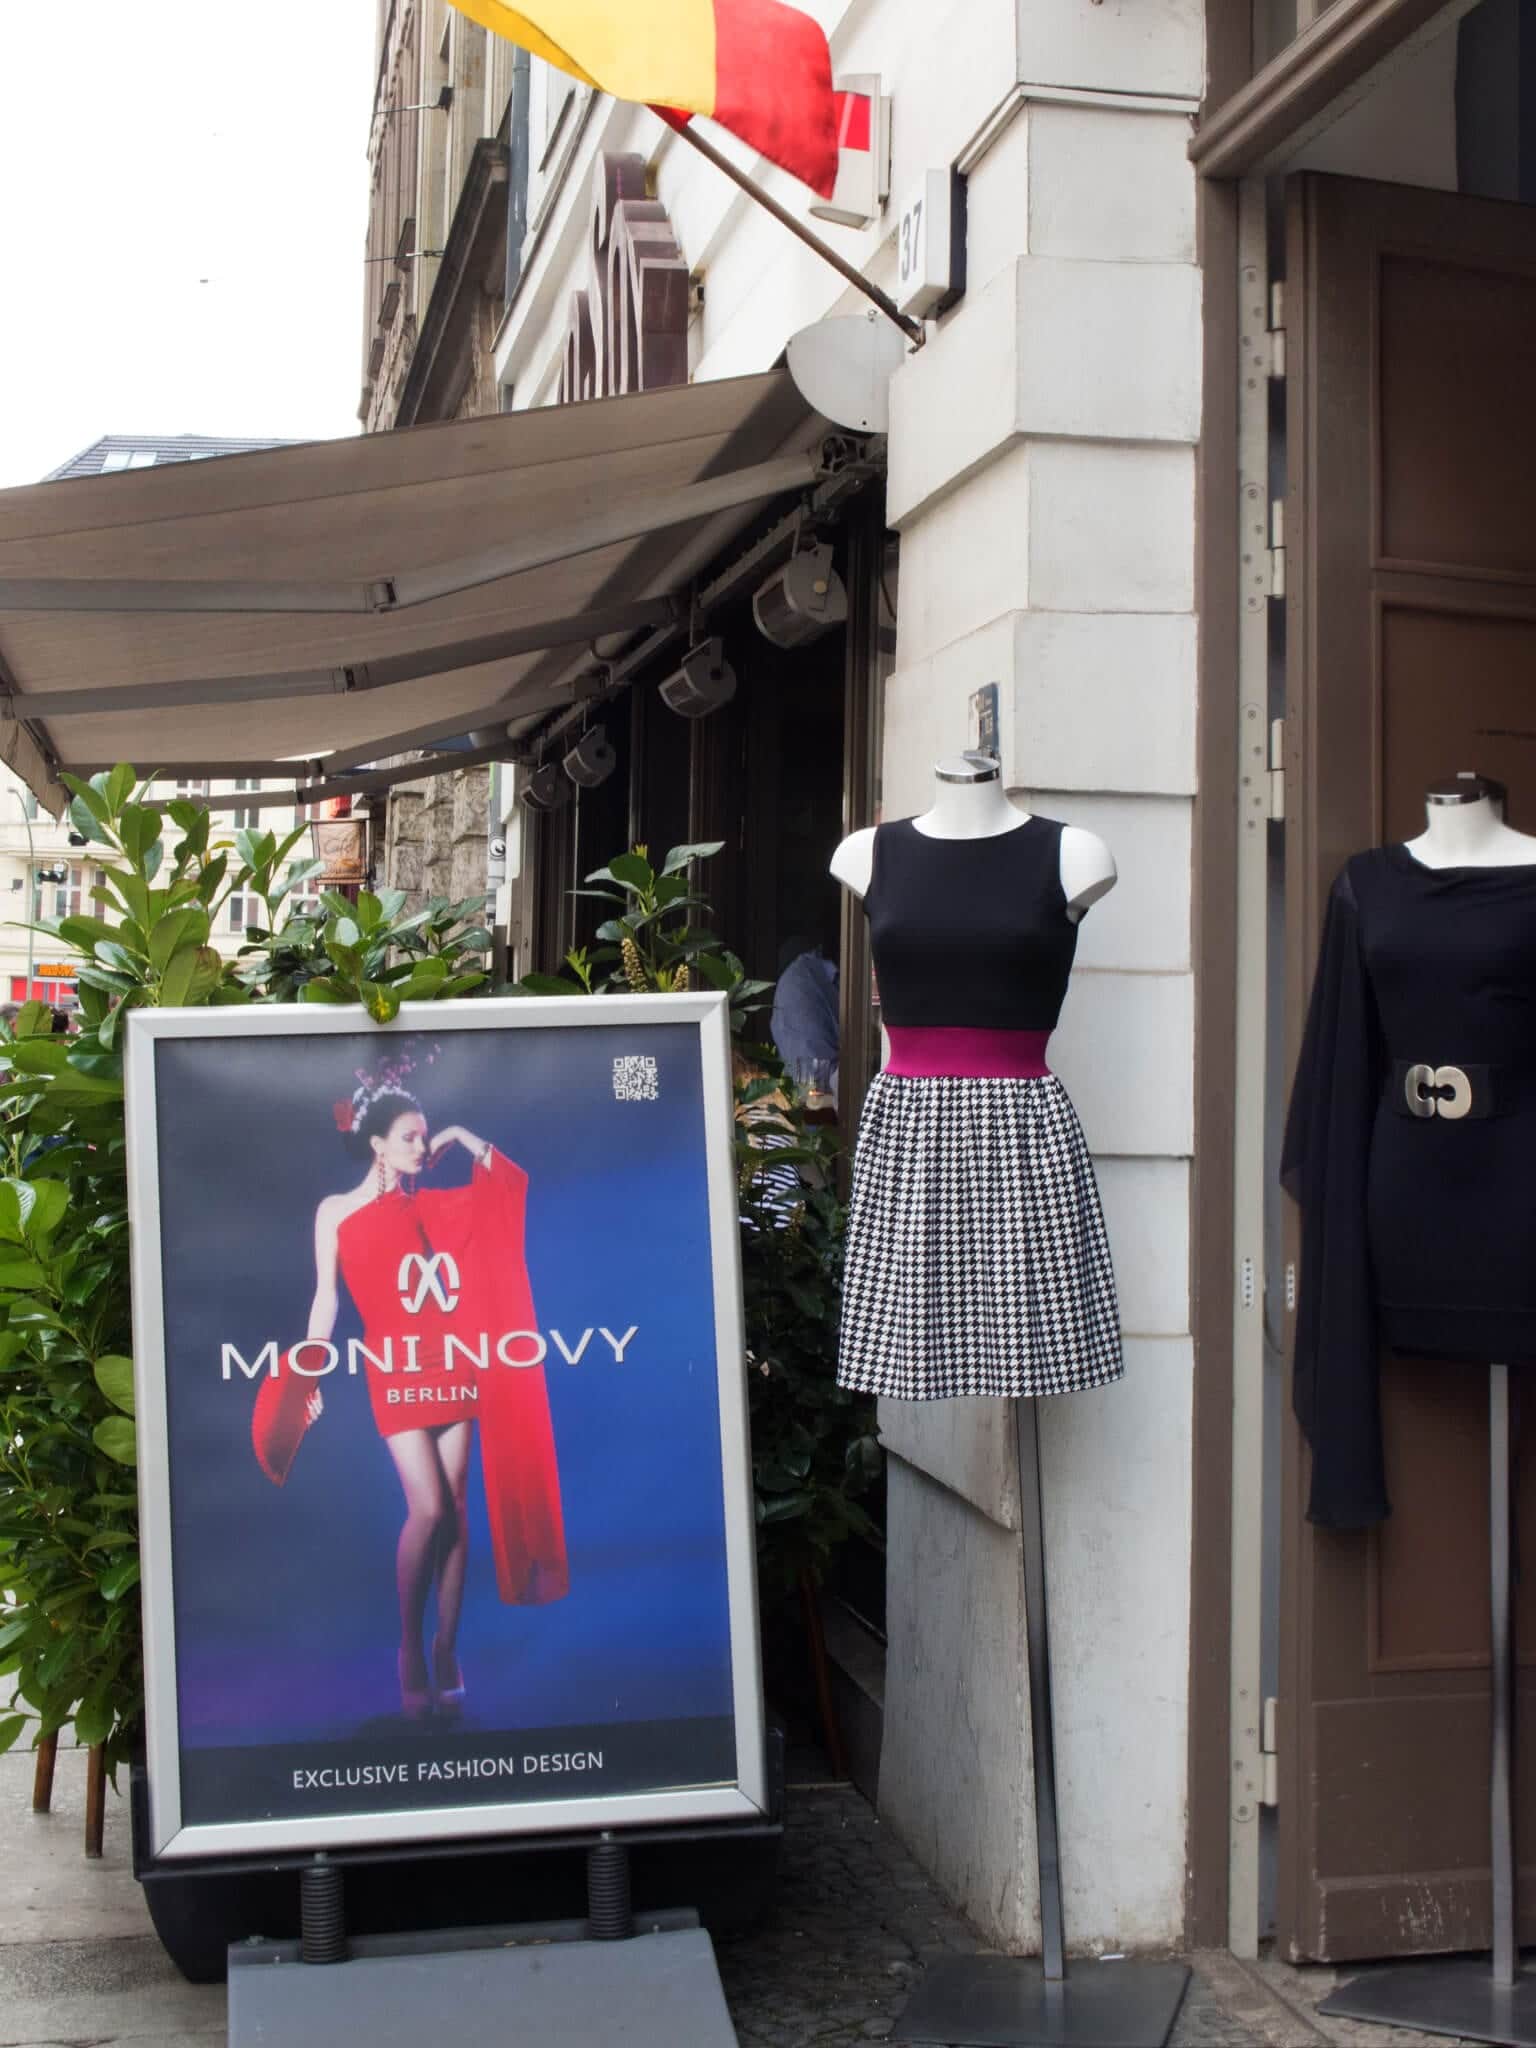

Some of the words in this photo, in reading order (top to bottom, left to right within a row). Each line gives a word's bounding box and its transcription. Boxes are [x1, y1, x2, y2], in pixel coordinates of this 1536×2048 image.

[901, 199, 922, 281] 37
[221, 1335, 422, 1380] MONI
[443, 1326, 639, 1371] NOVY
[386, 1385, 479, 1404] BERLIN
[292, 1764, 409, 1788] EXCLUSIVE
[417, 1757, 514, 1781] FASHION
[523, 1751, 604, 1774] DESIGN
